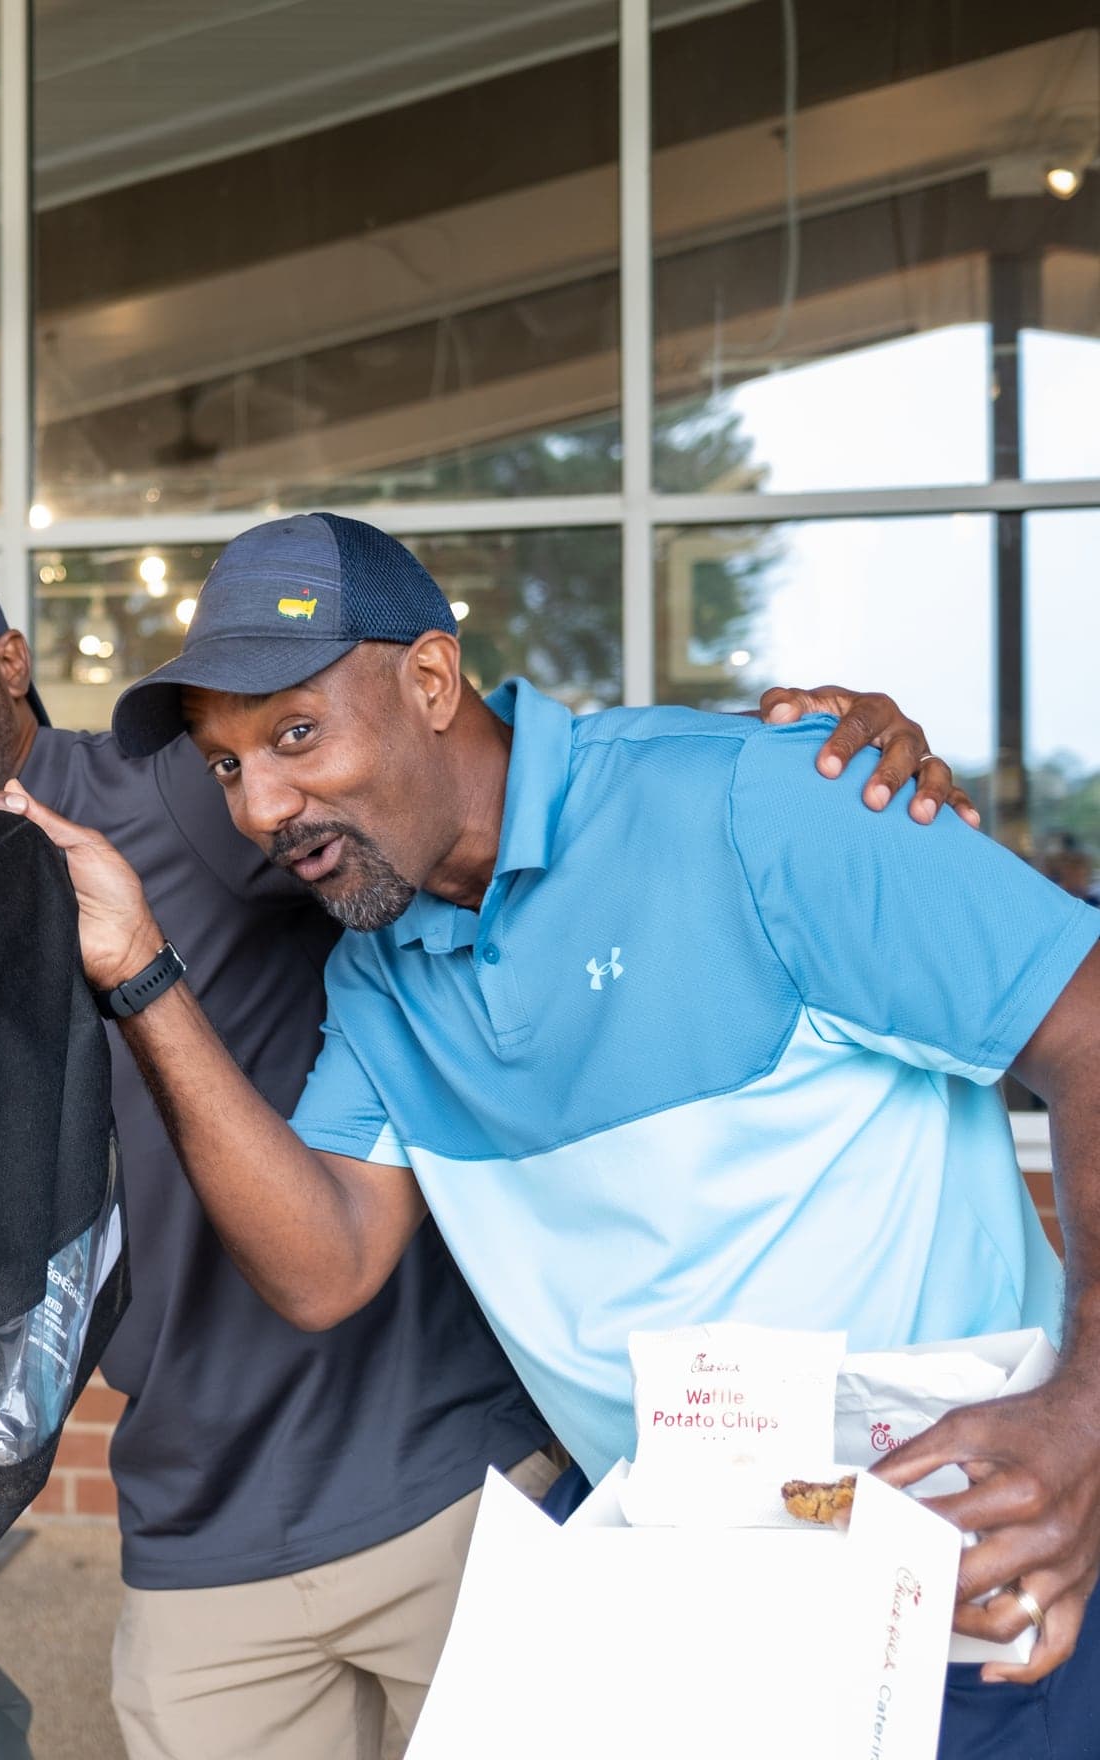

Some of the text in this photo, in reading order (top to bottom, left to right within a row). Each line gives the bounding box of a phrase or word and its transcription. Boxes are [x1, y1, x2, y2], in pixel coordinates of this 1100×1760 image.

[652, 1410, 779, 1433] Potato Chips
[883, 1566, 921, 1670] ChickfilA
